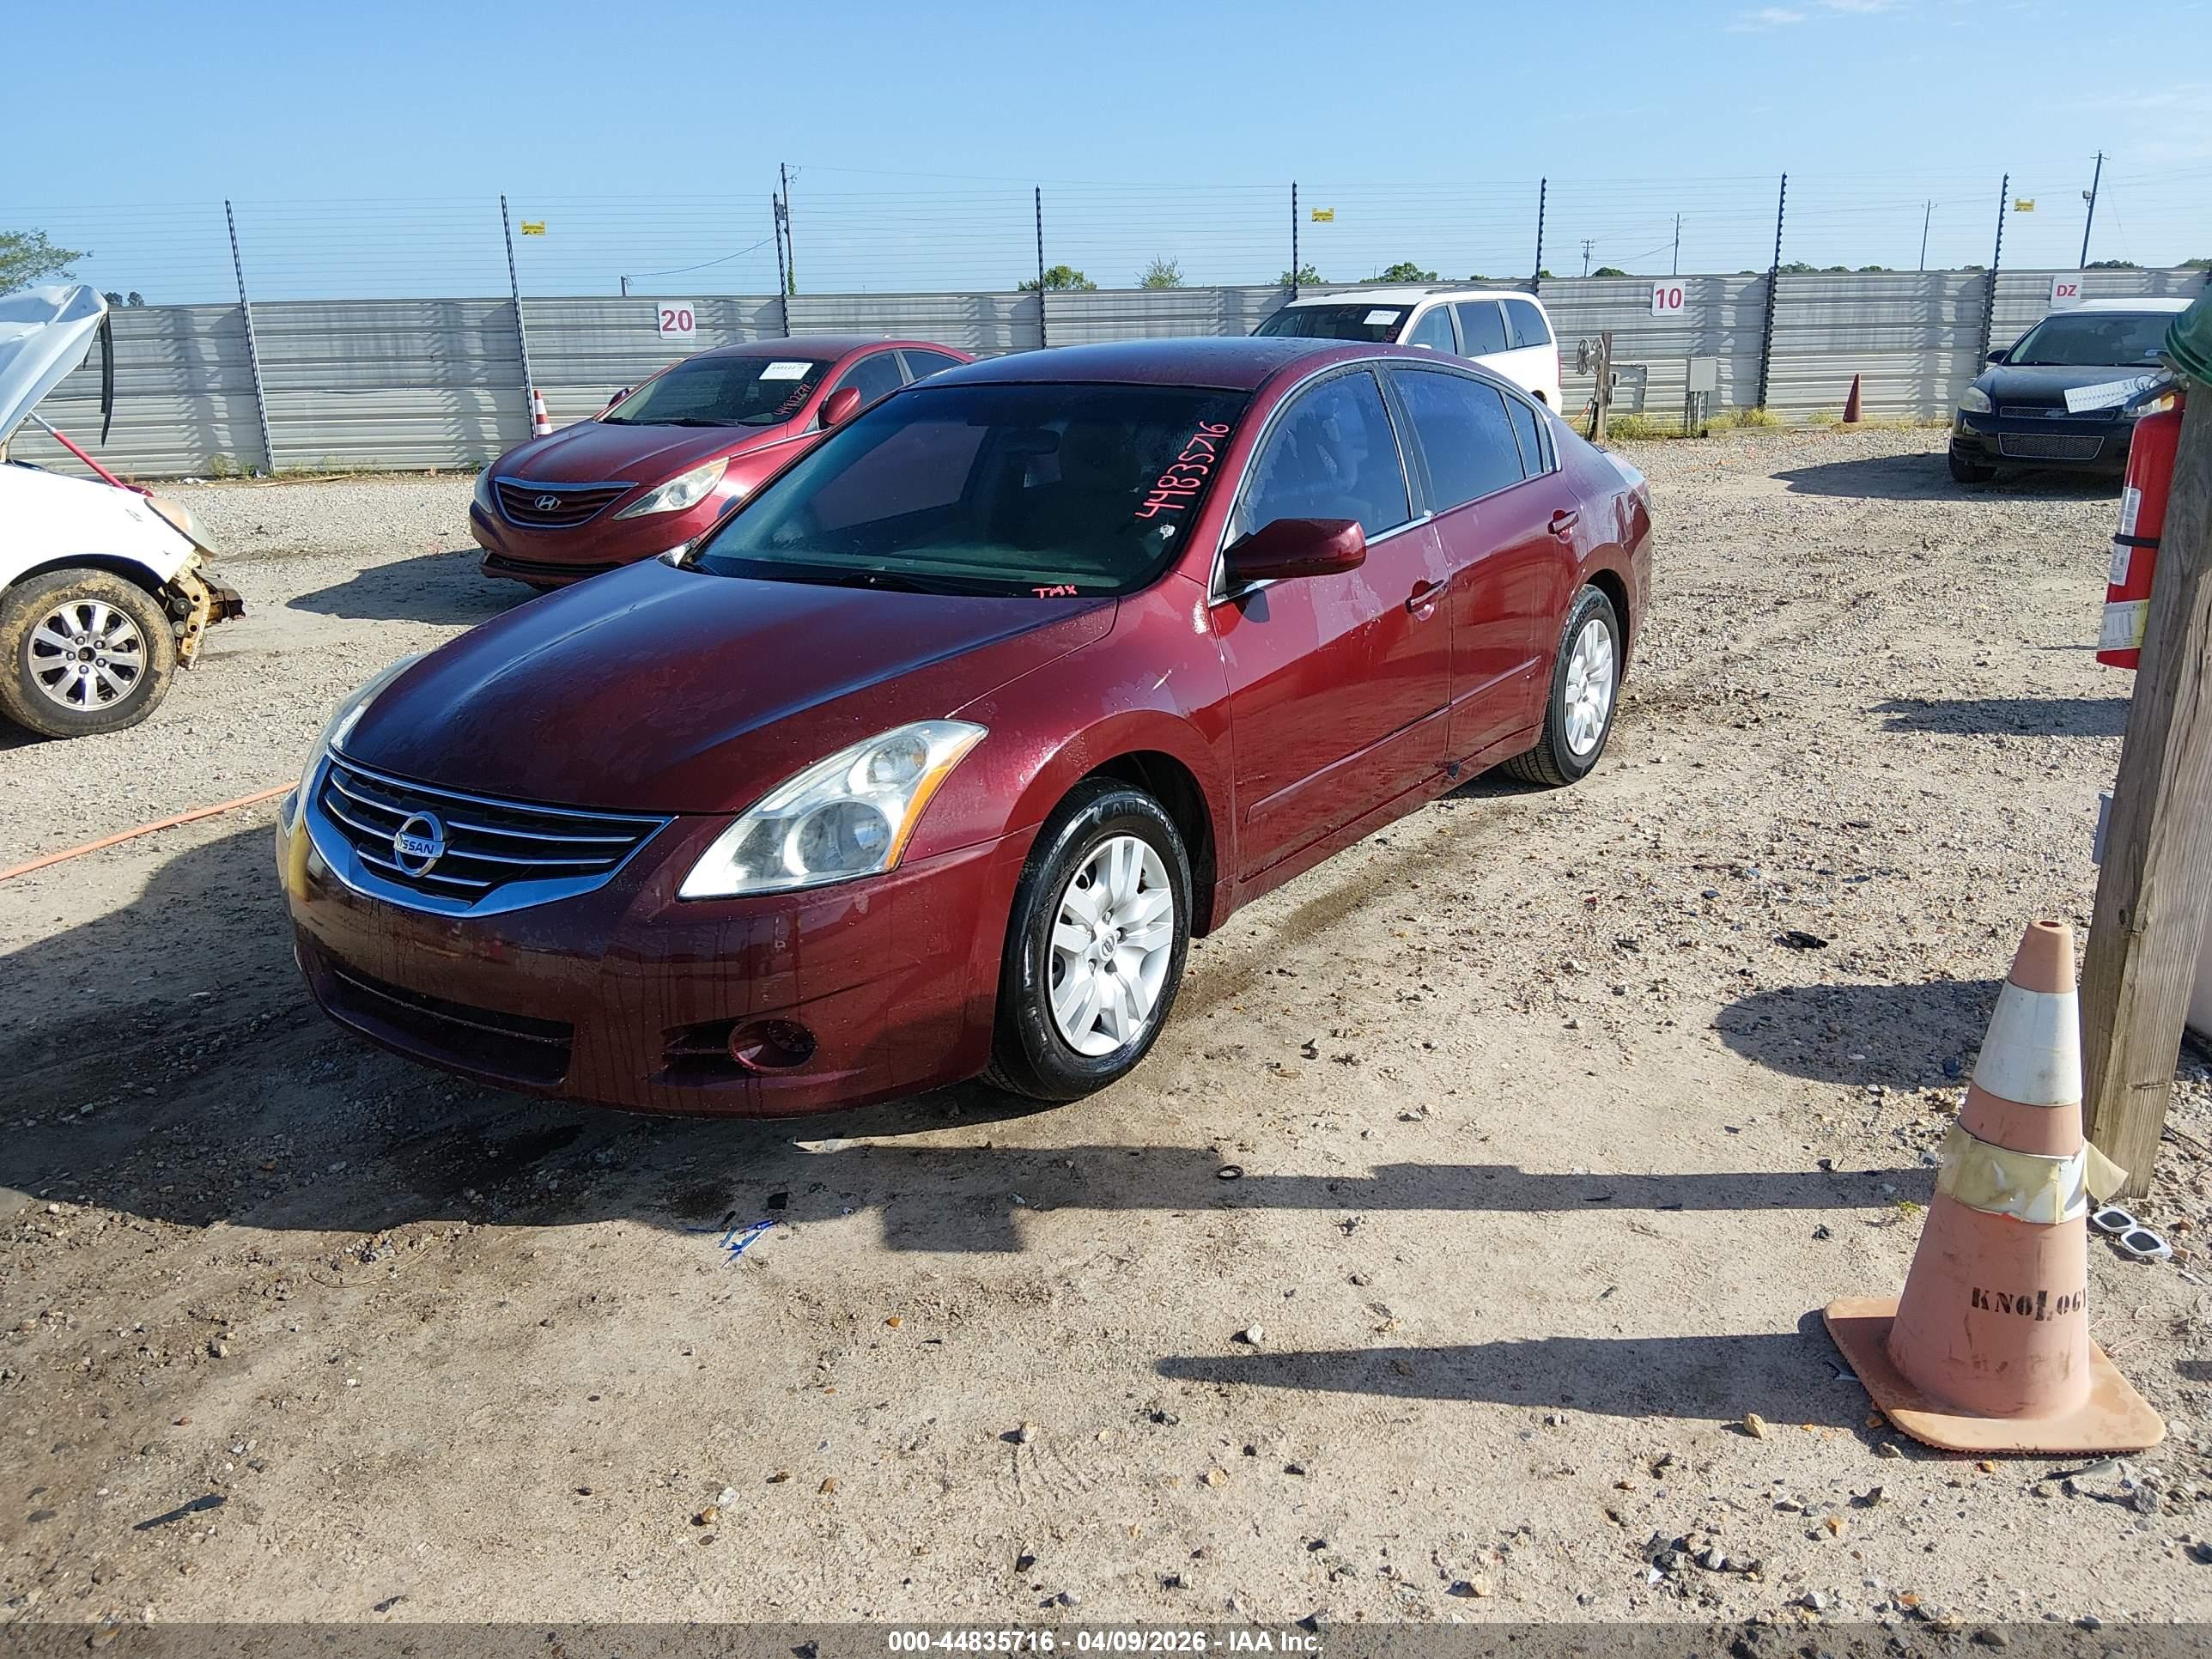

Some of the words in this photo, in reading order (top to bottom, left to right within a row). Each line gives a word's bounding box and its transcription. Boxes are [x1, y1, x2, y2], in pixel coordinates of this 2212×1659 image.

[1656, 288, 1682, 309] 10
[2057, 284, 2077, 297] DZ
[661, 309, 693, 331] 20
[1134, 420, 1230, 518] 44835716
[397, 832, 434, 854] NISSAN
